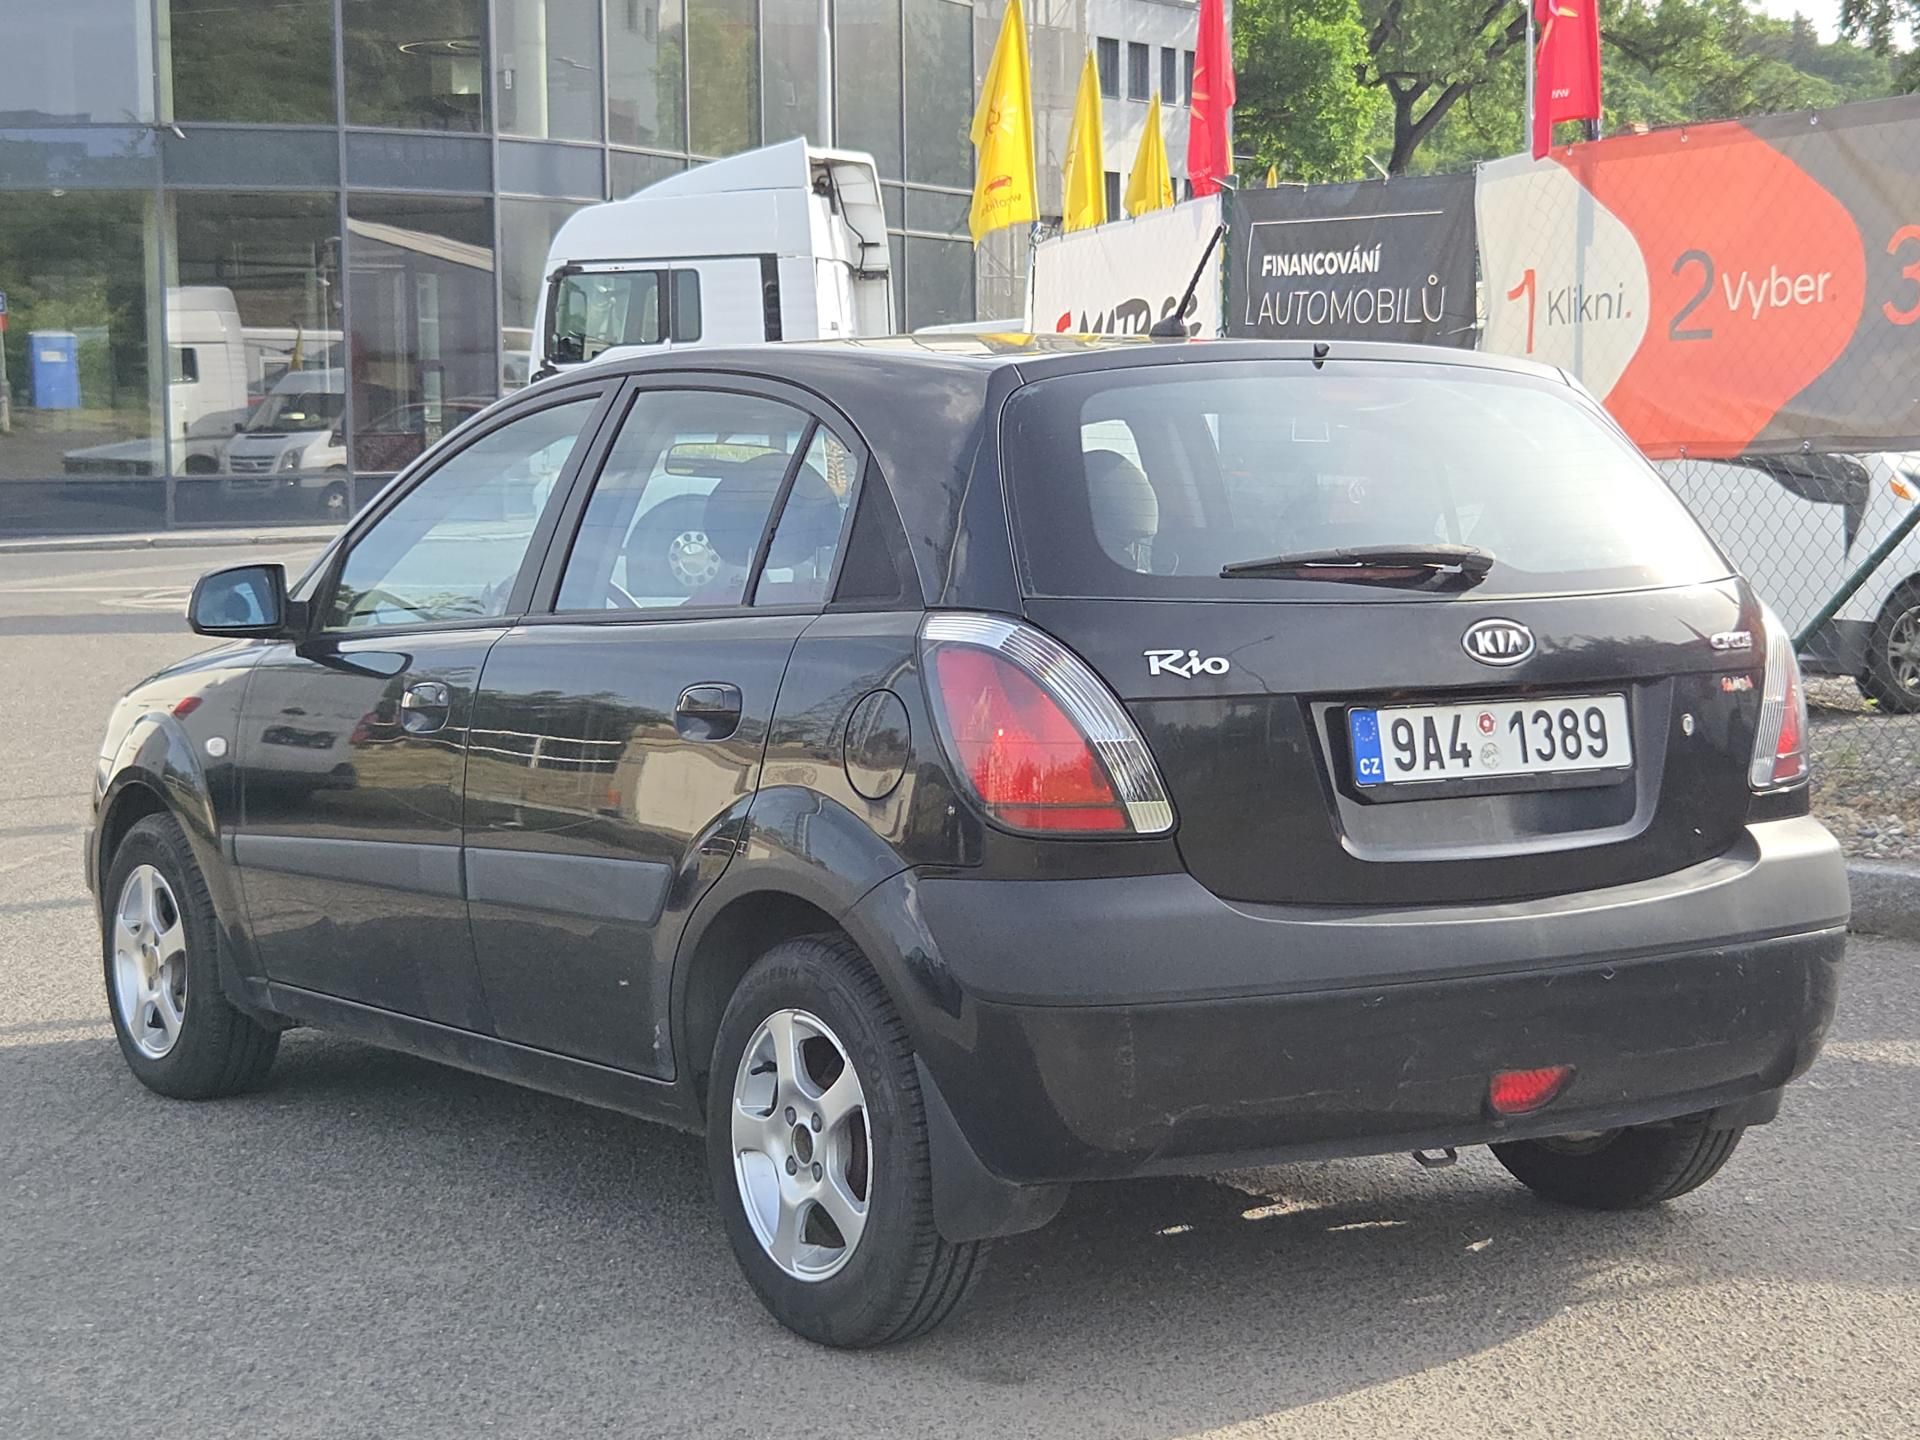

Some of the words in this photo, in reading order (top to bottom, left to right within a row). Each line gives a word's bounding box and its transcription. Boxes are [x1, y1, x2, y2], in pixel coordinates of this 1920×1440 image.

[1261, 243, 1382, 277] FINANCOVÁNÍ
[1258, 274, 1446, 325] AUTOMOBILŮ
[1507, 269, 1535, 354] 1
[1548, 283, 1632, 325] Klikni.
[1669, 249, 1714, 341] 2
[1474, 630, 1524, 655] KIA
[1143, 649, 1230, 679] Rio
[1391, 714, 1472, 771] 9A4
[1509, 706, 1608, 763] 1389
[1360, 757, 1381, 775] CZ
